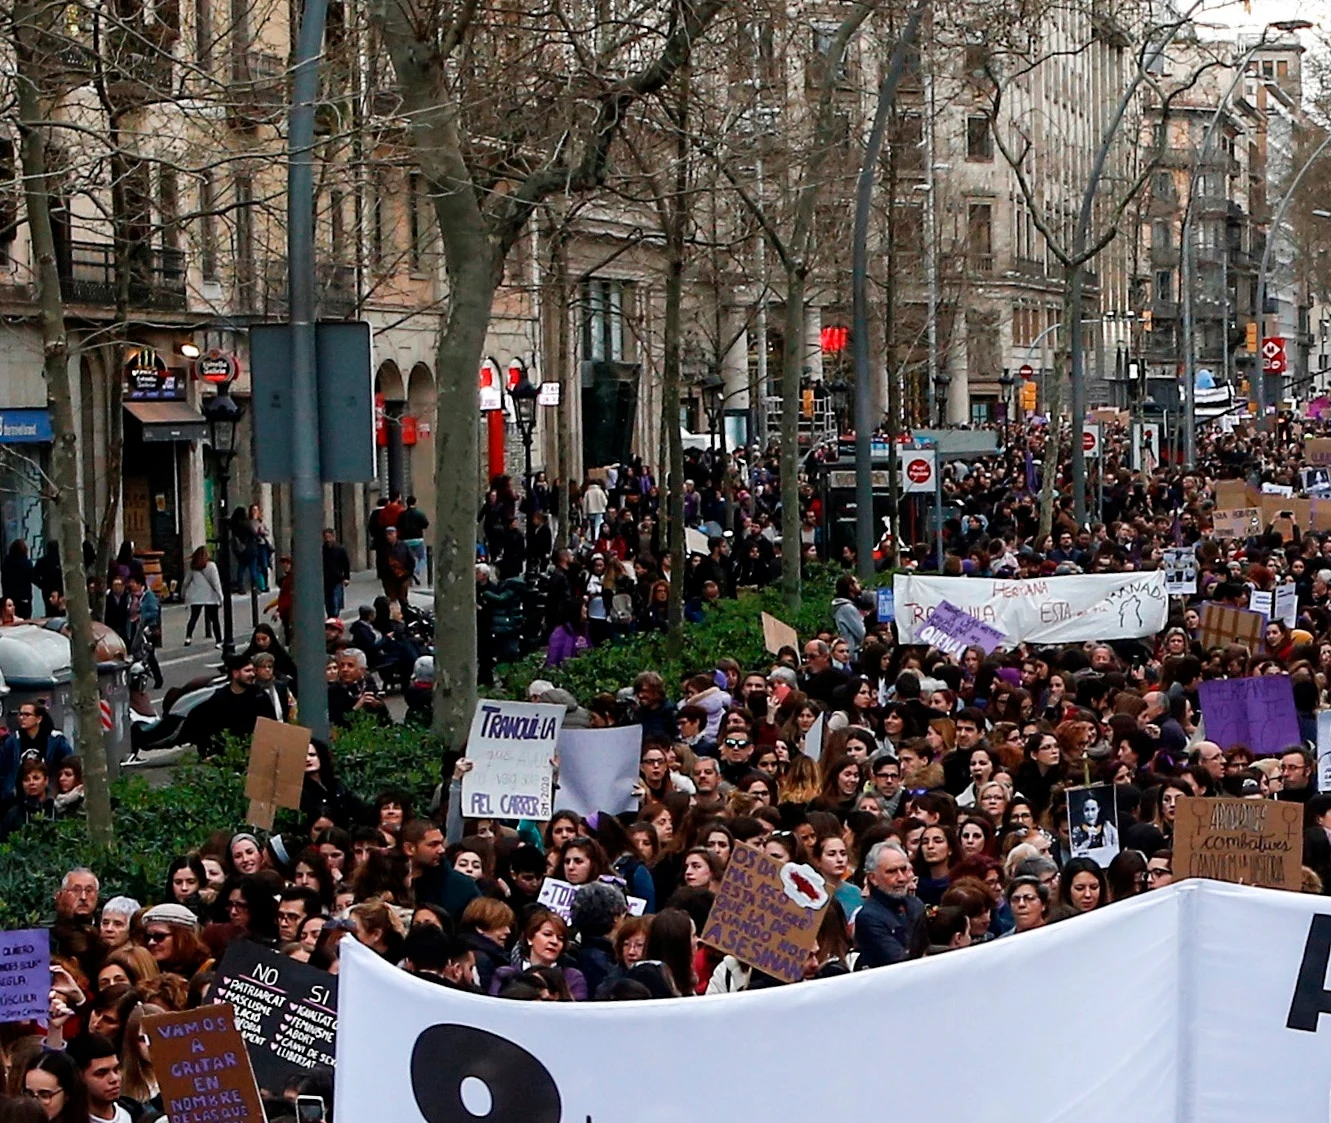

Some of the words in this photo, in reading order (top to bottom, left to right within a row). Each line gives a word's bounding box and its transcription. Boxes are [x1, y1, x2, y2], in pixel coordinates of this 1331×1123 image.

[471, 793, 494, 815] PEL
[733, 847, 759, 869] OS
[252, 963, 279, 986] NO
[229, 979, 287, 1008] PATRIARCAT
[309, 985, 331, 1006] SI
[296, 1005, 333, 1027] IGUALTAT
[158, 1017, 227, 1039] VAMOS
[285, 1028, 316, 1046] ABORT
[290, 1016, 335, 1044] FEMINISME
[190, 1037, 206, 1053] A
[306, 1048, 319, 1060] DE
[319, 1053, 337, 1068] SEX
[193, 1075, 220, 1092] EN
[170, 1089, 243, 1113] NOMBRE
[194, 1110, 220, 1122] LAS
[221, 1105, 249, 1119] QUE
